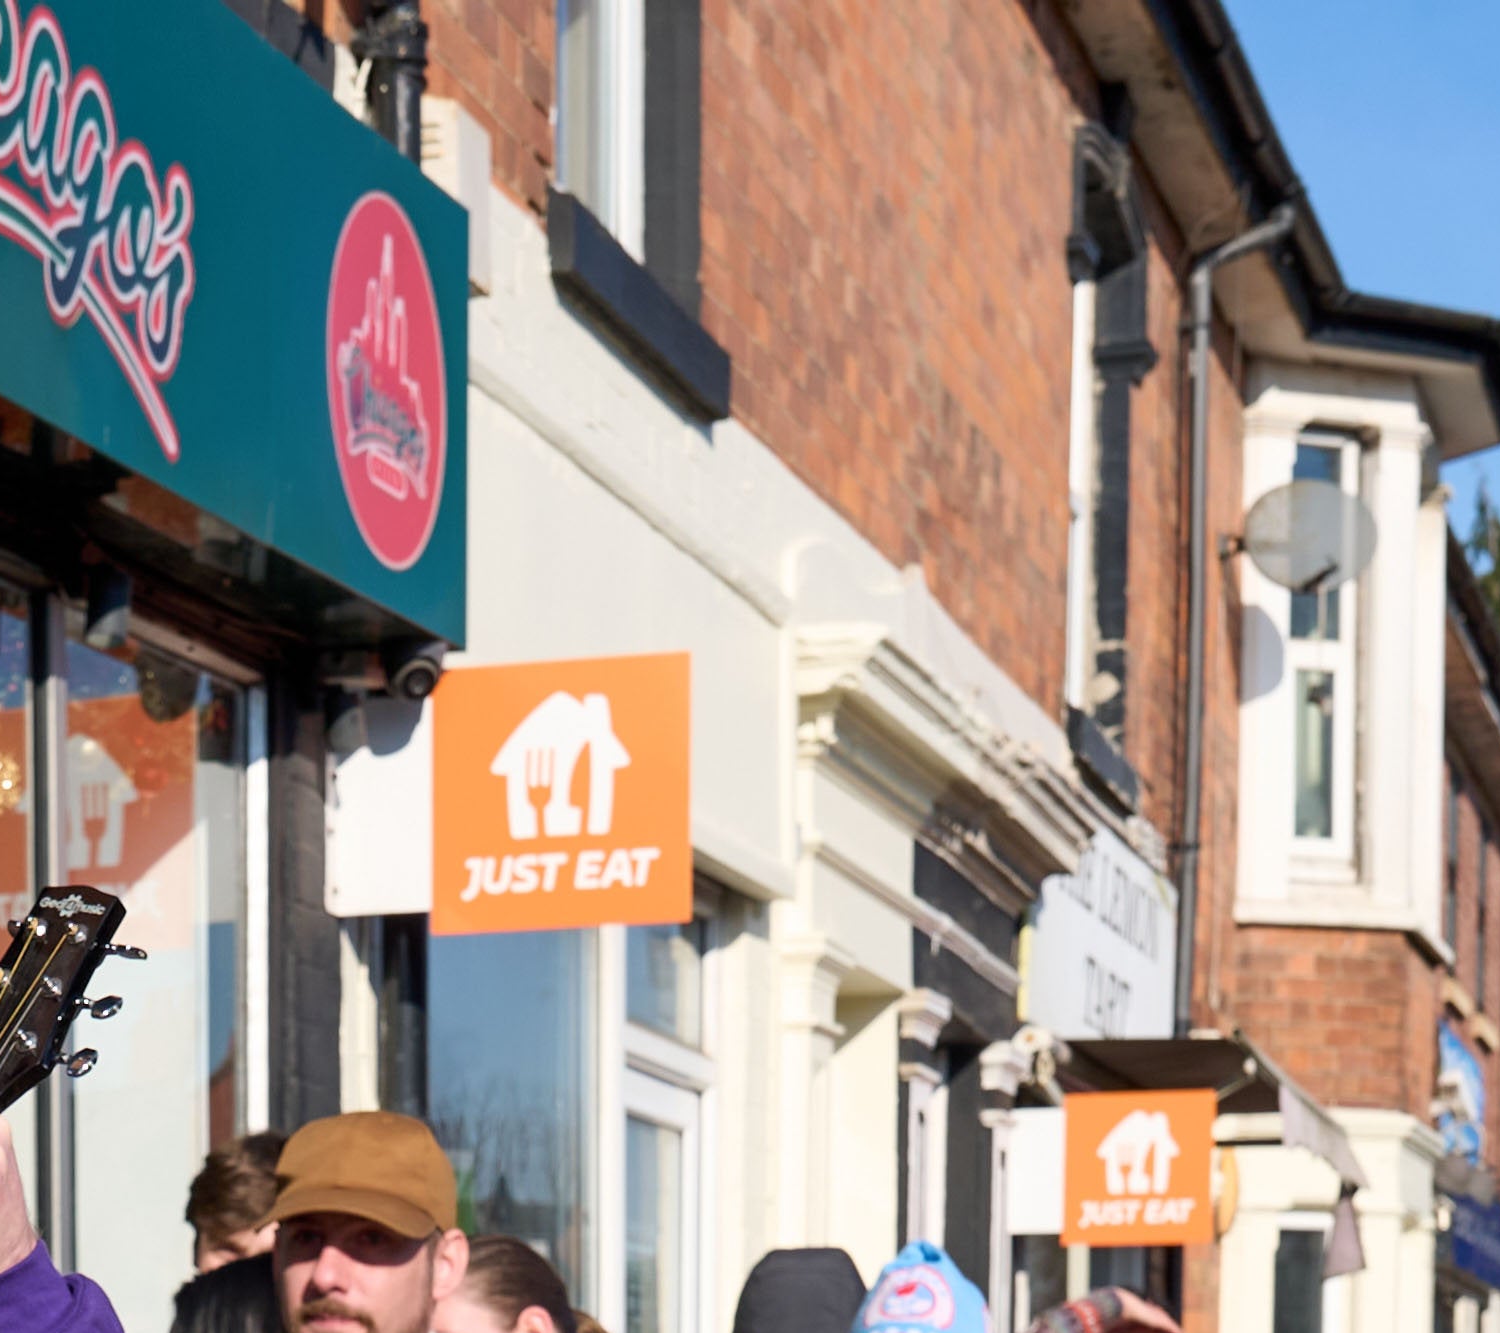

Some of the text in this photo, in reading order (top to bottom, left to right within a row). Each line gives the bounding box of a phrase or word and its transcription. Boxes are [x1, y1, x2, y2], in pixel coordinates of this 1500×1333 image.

[461, 847, 660, 902] JUST EAT
[1078, 1197, 1195, 1228] JUST EAT
